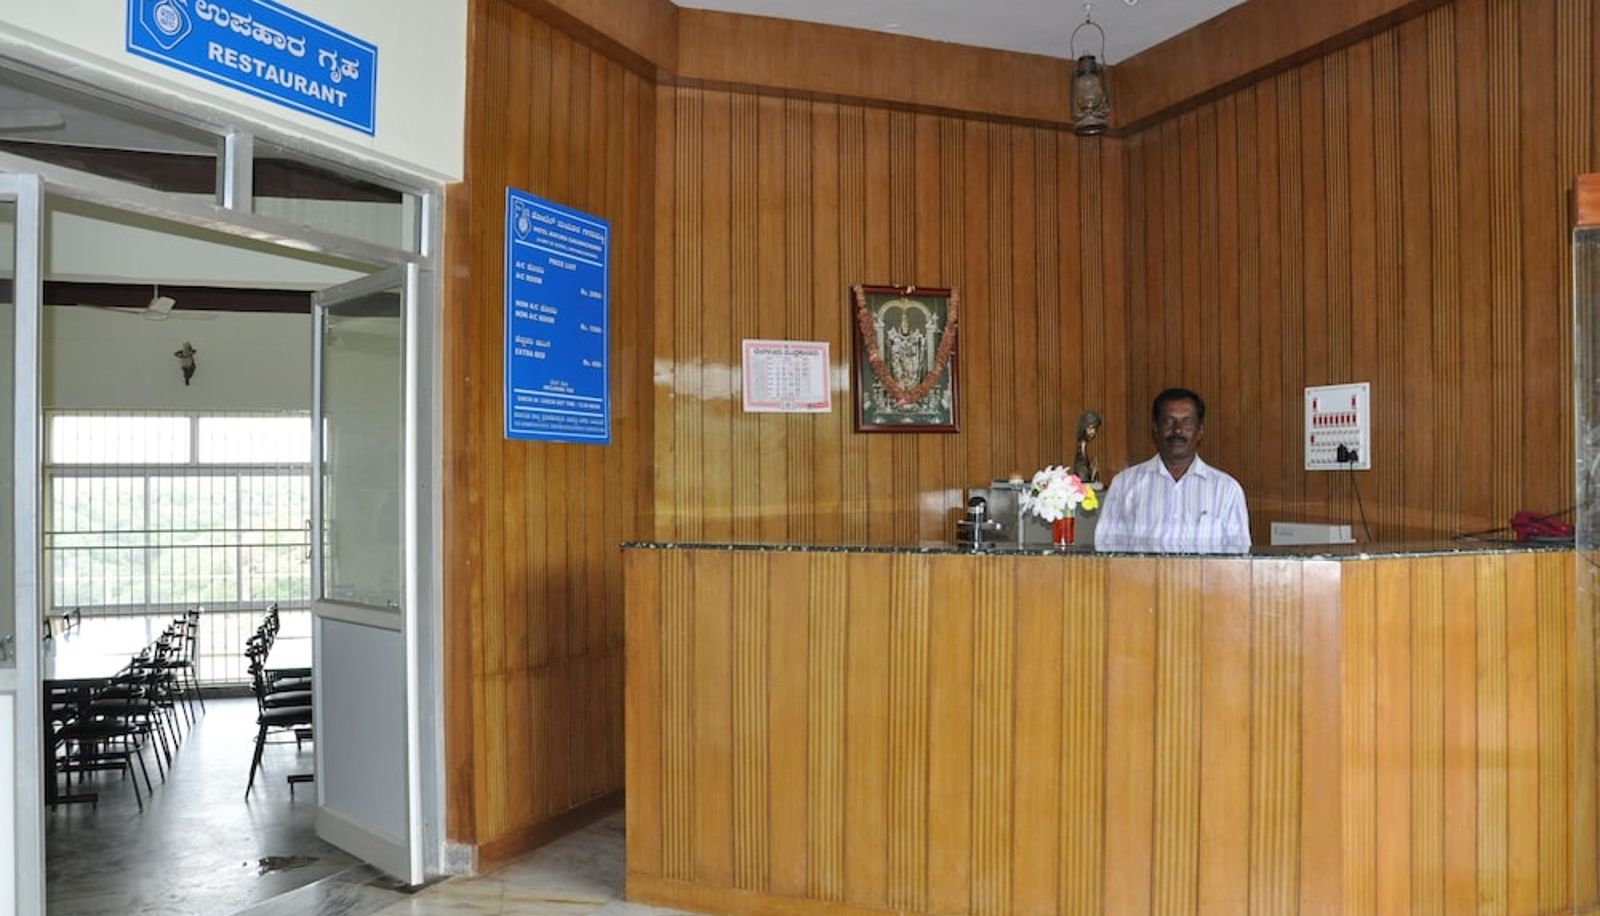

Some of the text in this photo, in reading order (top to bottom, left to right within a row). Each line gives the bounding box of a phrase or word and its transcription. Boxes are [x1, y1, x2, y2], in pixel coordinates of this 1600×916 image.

[195, 0, 306, 57] ಉಪಹಾರ
[318, 48, 360, 84] ಗೃಹ
[208, 41, 348, 108] RESTAURANT
